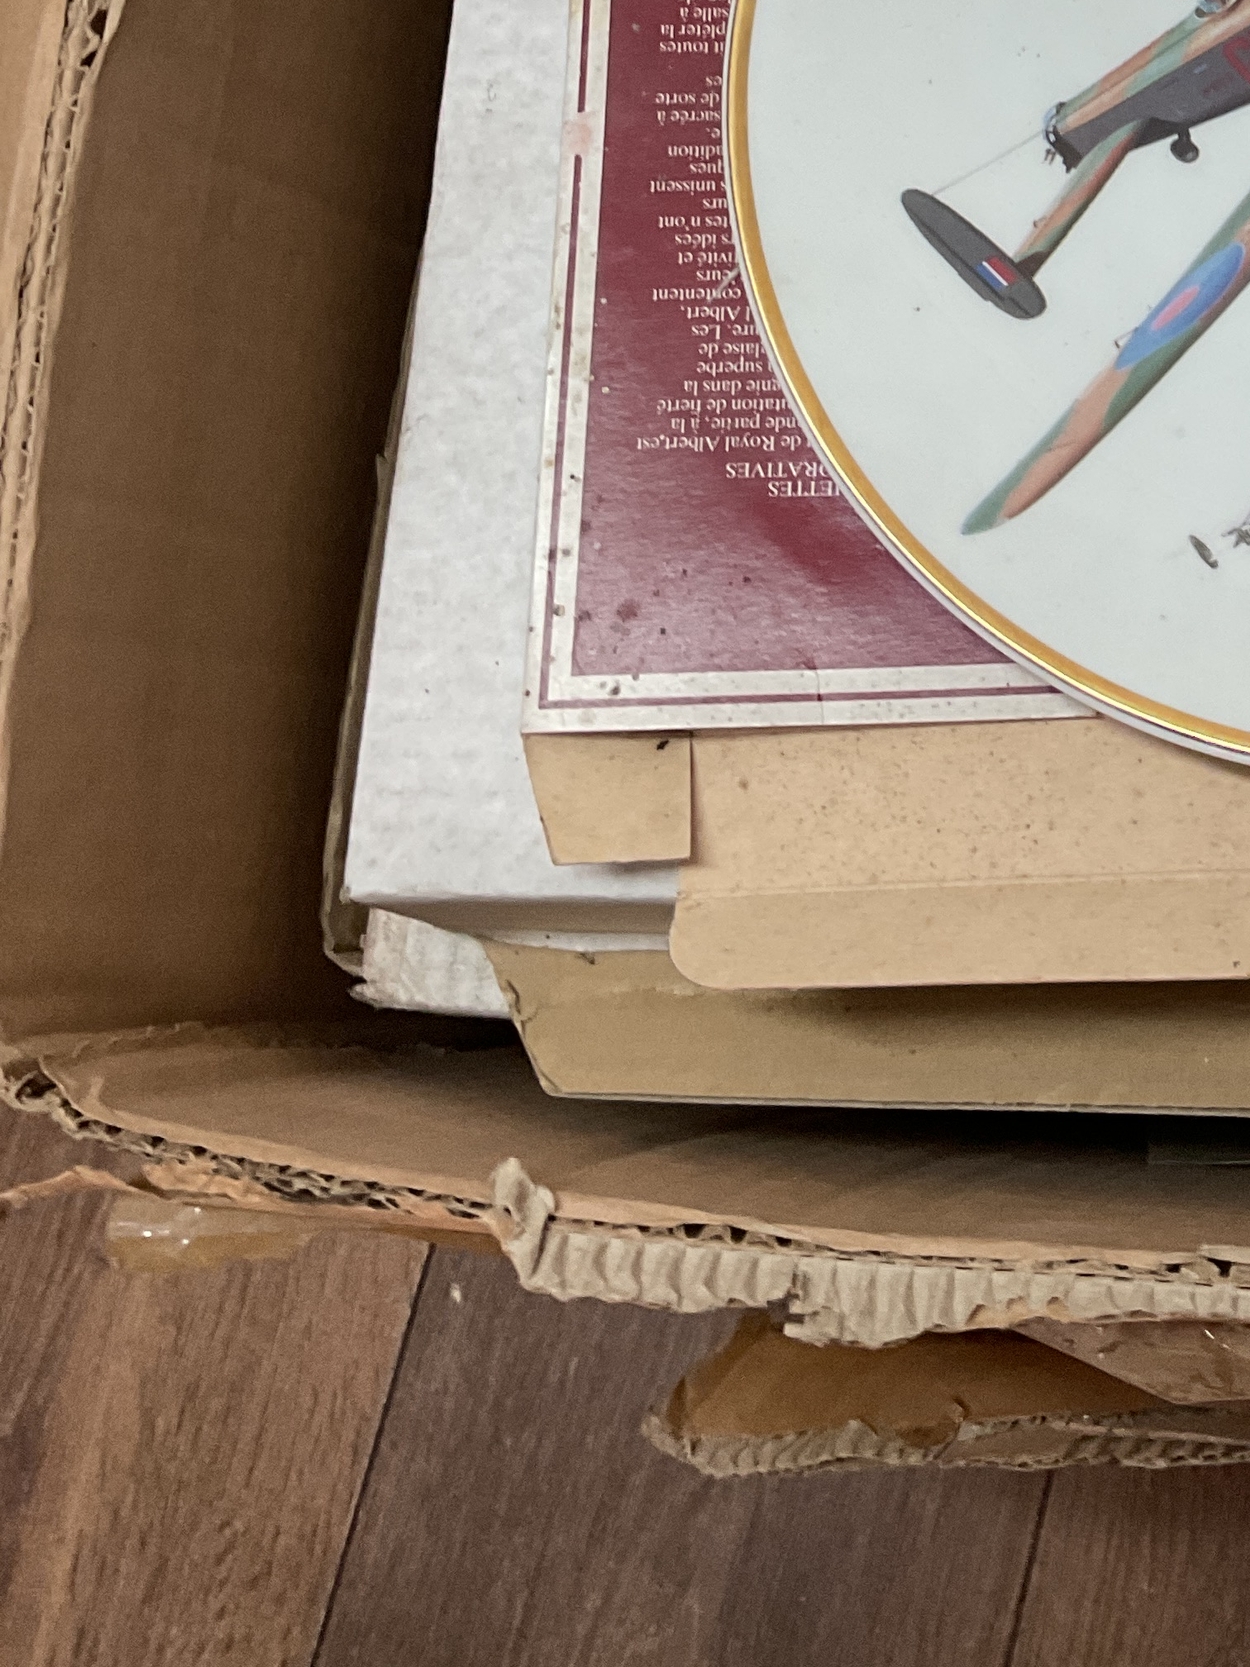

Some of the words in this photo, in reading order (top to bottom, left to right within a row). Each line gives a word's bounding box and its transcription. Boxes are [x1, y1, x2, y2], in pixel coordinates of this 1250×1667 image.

[679, 7, 689, 22] à
[693, 7, 730, 22] salle
[660, 24, 674, 38] la
[678, 21, 726, 39] pléter
[659, 41, 709, 55] toutes
[655, 92, 696, 107] sorte
[700, 92, 720, 107] de
[656, 110, 666, 125] à
[670, 110, 721, 125] sacrée
[649, 180, 716, 195] unissent
[674, 233, 717, 249] idées
[678, 251, 693, 265] et
[697, 252, 732, 267] ivité
[696, 270, 736, 285] eurs
[652, 287, 742, 303] contentent
[691, 324, 721, 340] Les
[698, 343, 719, 358] de
[722, 342, 765, 357] laise
[696, 356, 763, 376] superbe
[683, 380, 697, 396] la
[703, 379, 742, 396] dans
[745, 378, 781, 396] gnie
[657, 398, 701, 417] fierté
[706, 398, 727, 415] de
[731, 398, 791, 413] utation
[670, 417, 685, 433] la
[690, 417, 700, 434] à
[704, 414, 760, 433] partie,
[764, 417, 799, 432] nde
[725, 431, 775, 452] Royal
[780, 435, 801, 452] de
[768, 480, 839, 497] IETTES
